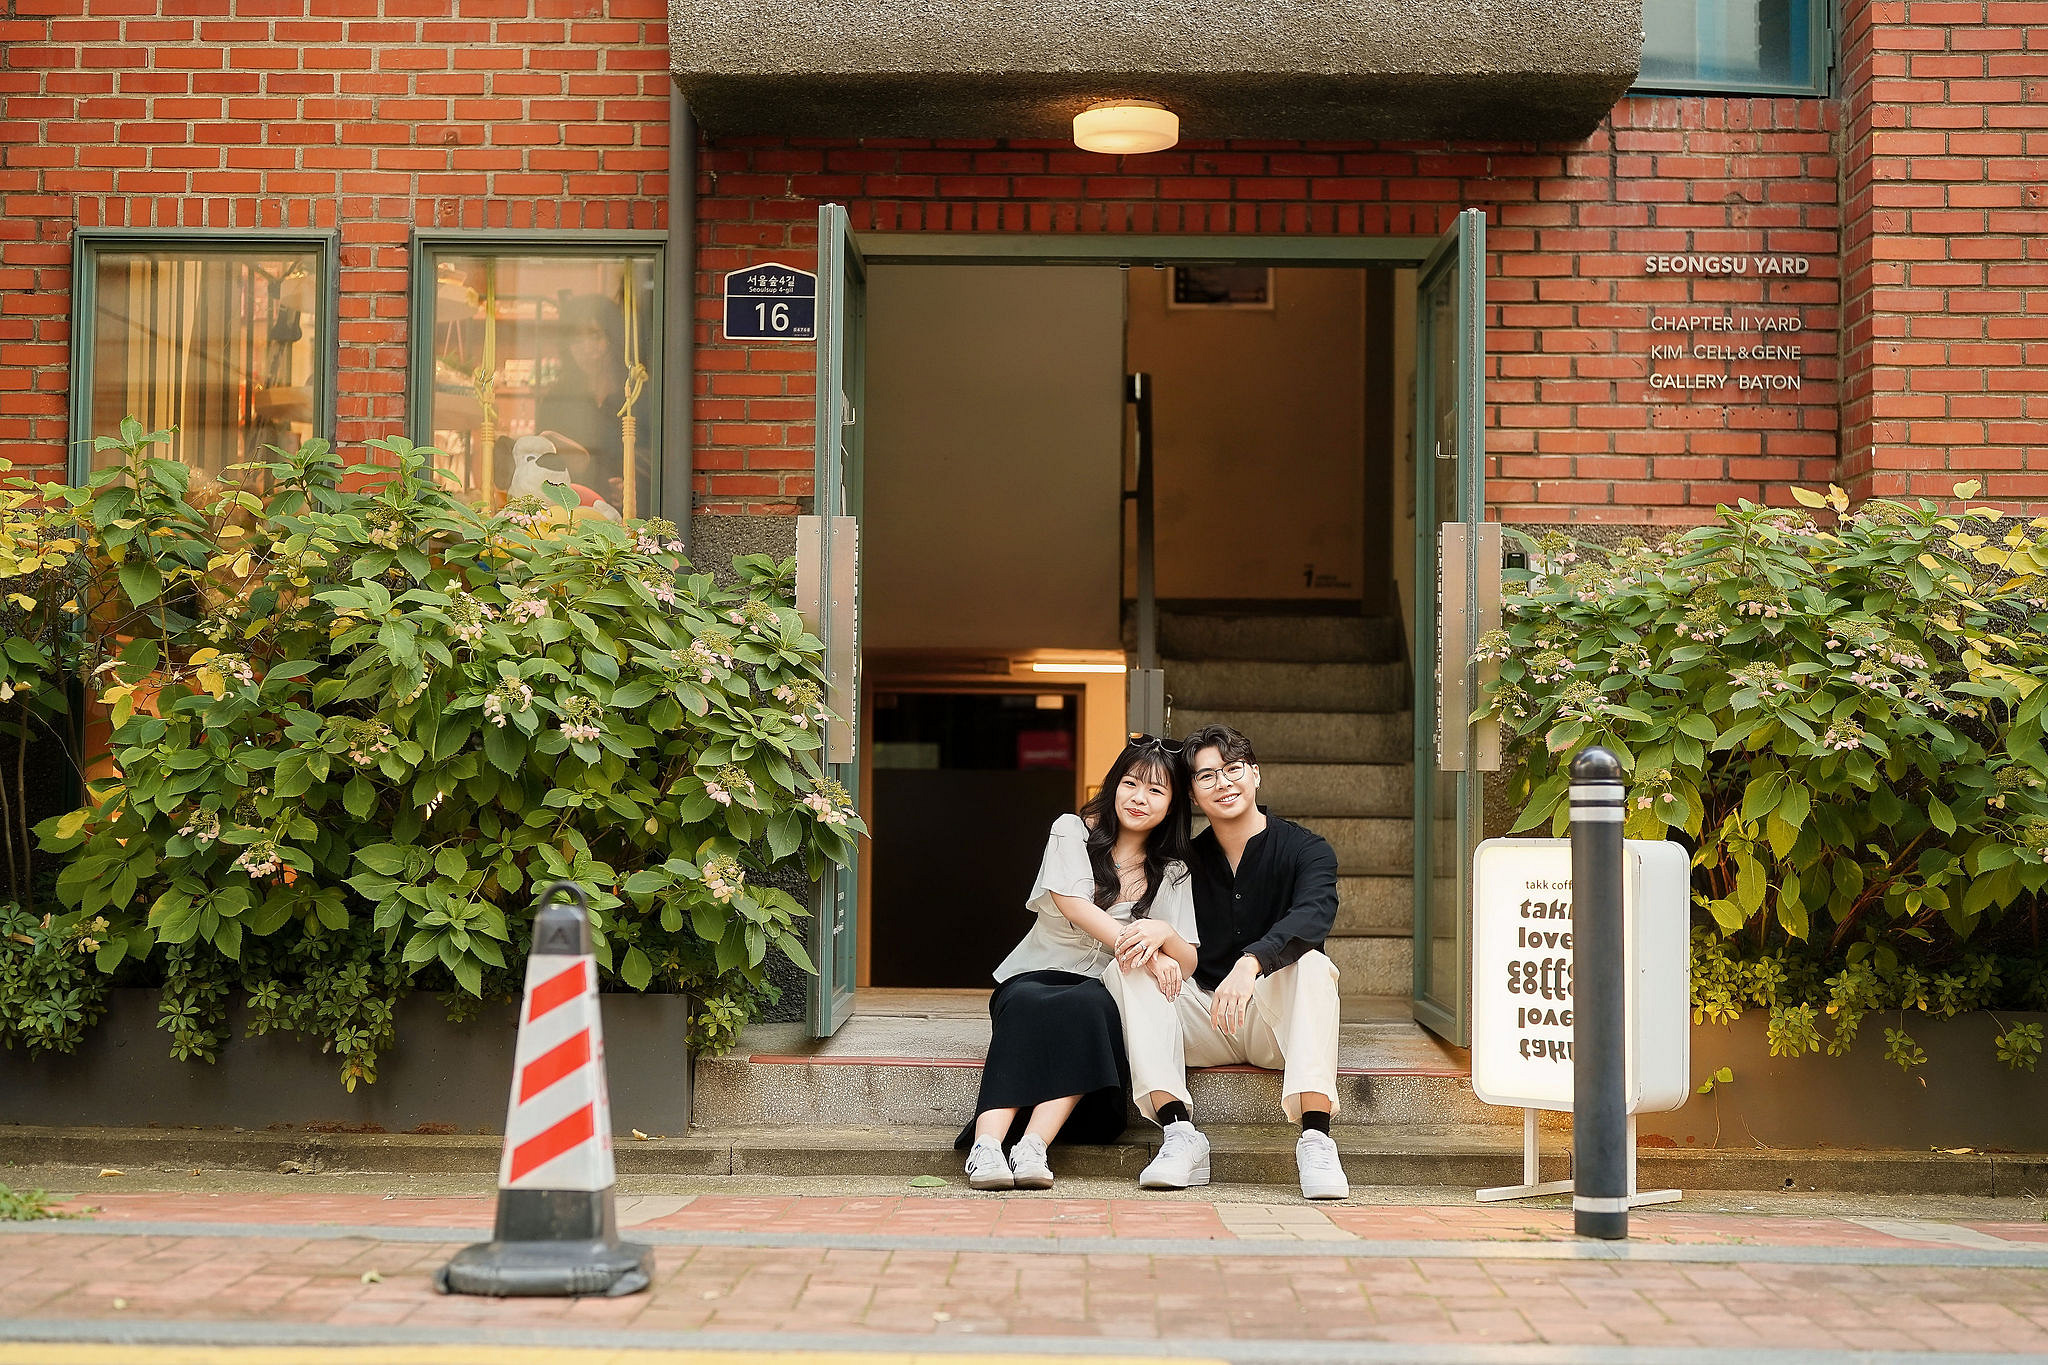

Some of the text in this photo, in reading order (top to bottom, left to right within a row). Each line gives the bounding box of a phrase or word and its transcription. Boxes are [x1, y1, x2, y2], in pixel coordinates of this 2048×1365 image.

[1645, 256, 1809, 274] SEONGSU YARD
[747, 275, 795, 287] 서울숲4길
[749, 286, 794, 294] Seoulsup 4-gil
[755, 302, 790, 332] 16
[1651, 316, 1733, 332] CHAPTER
[1754, 317, 1801, 332] YARD
[1651, 344, 1682, 360] KIM
[1649, 373, 1801, 390] GALLERY BATON
[1526, 880, 1573, 890] takk coff
[1518, 926, 1574, 950] love
